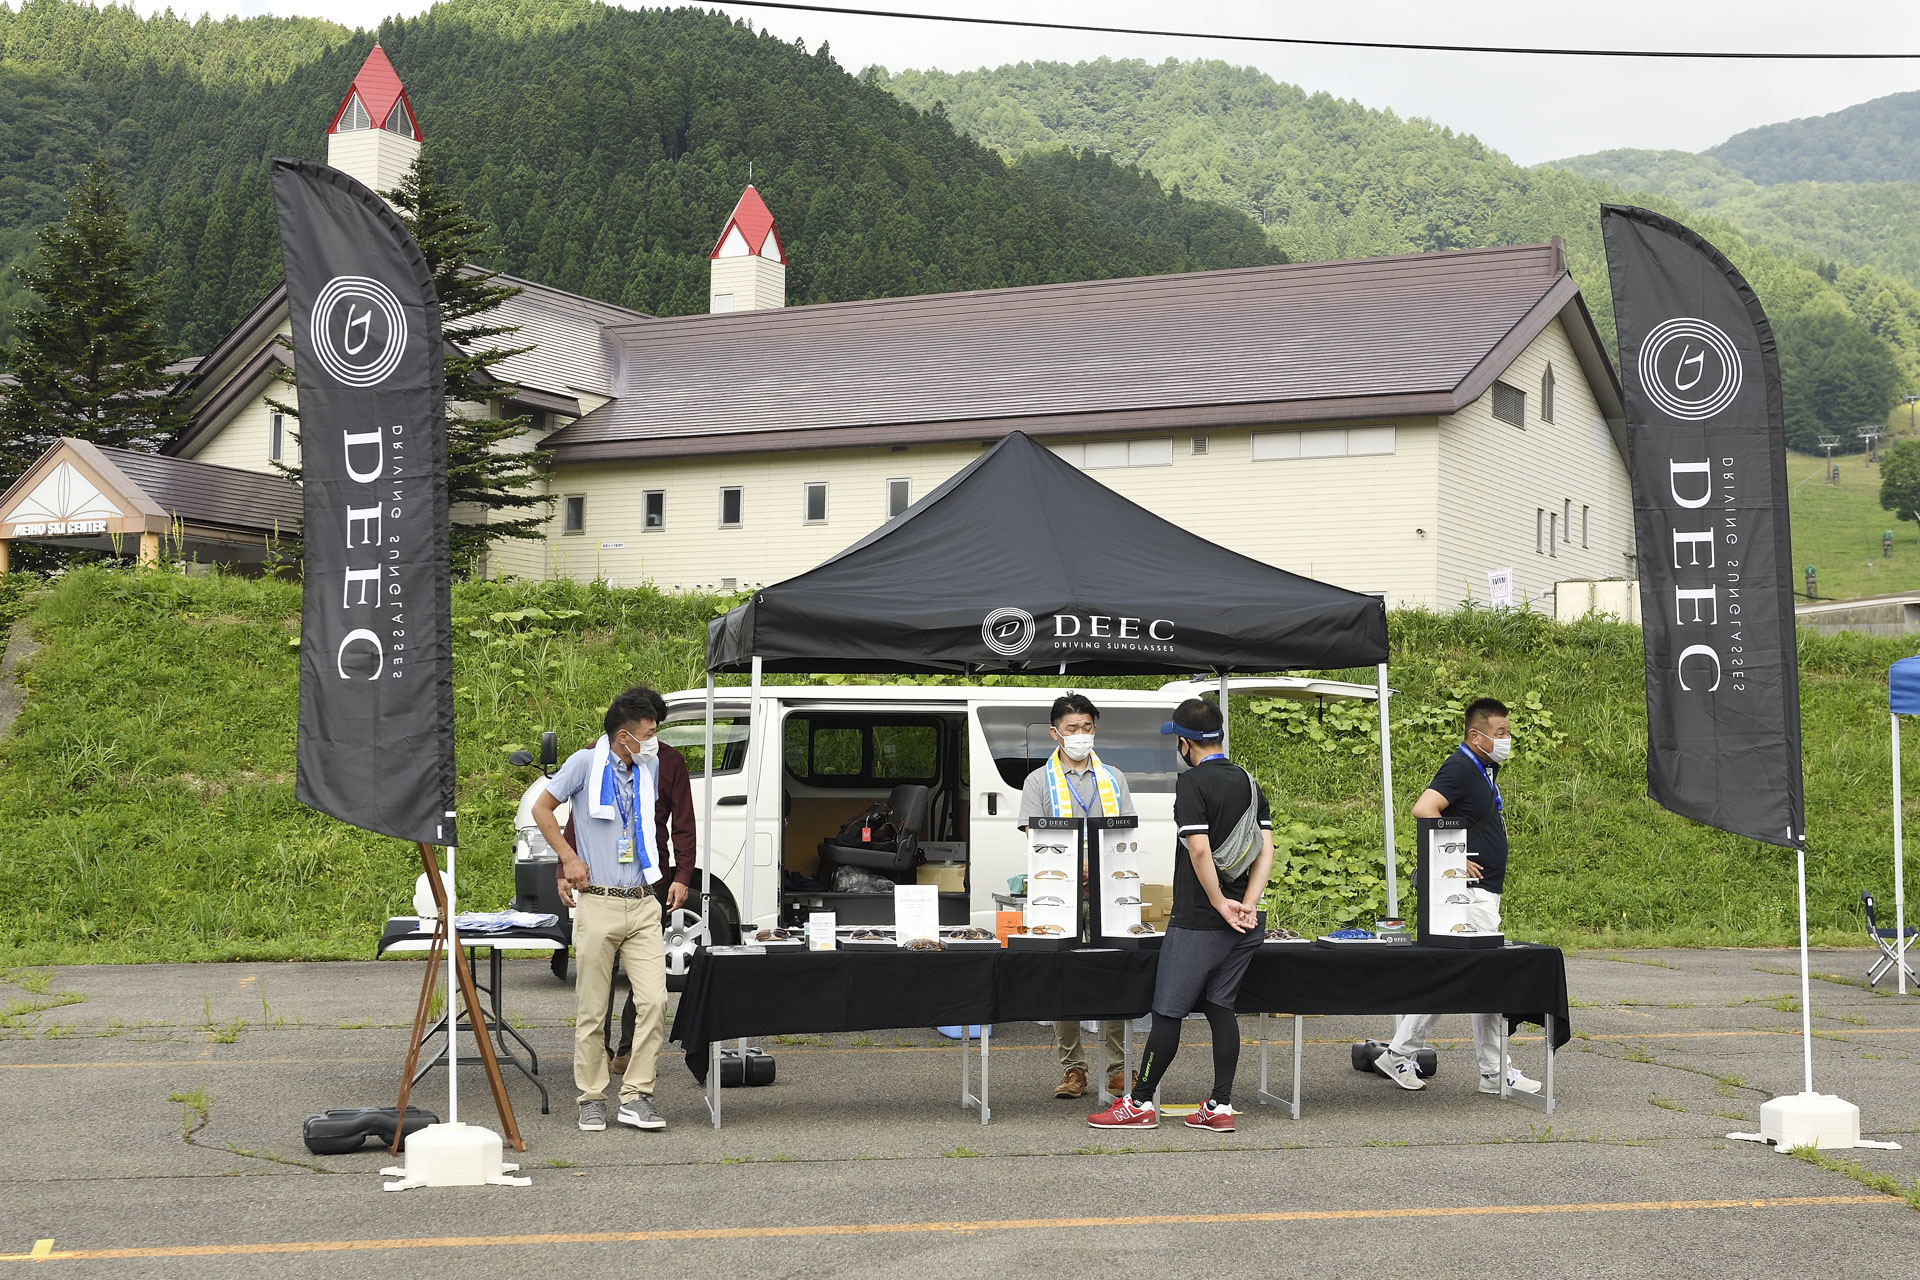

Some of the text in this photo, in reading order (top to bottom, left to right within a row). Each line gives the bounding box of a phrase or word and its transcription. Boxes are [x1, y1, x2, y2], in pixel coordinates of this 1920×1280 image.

[12, 520, 107, 536] MEIHO SKI CENTER
[1053, 614, 1175, 641] DEEC
[1107, 643, 1174, 652] SUNGLASSES
